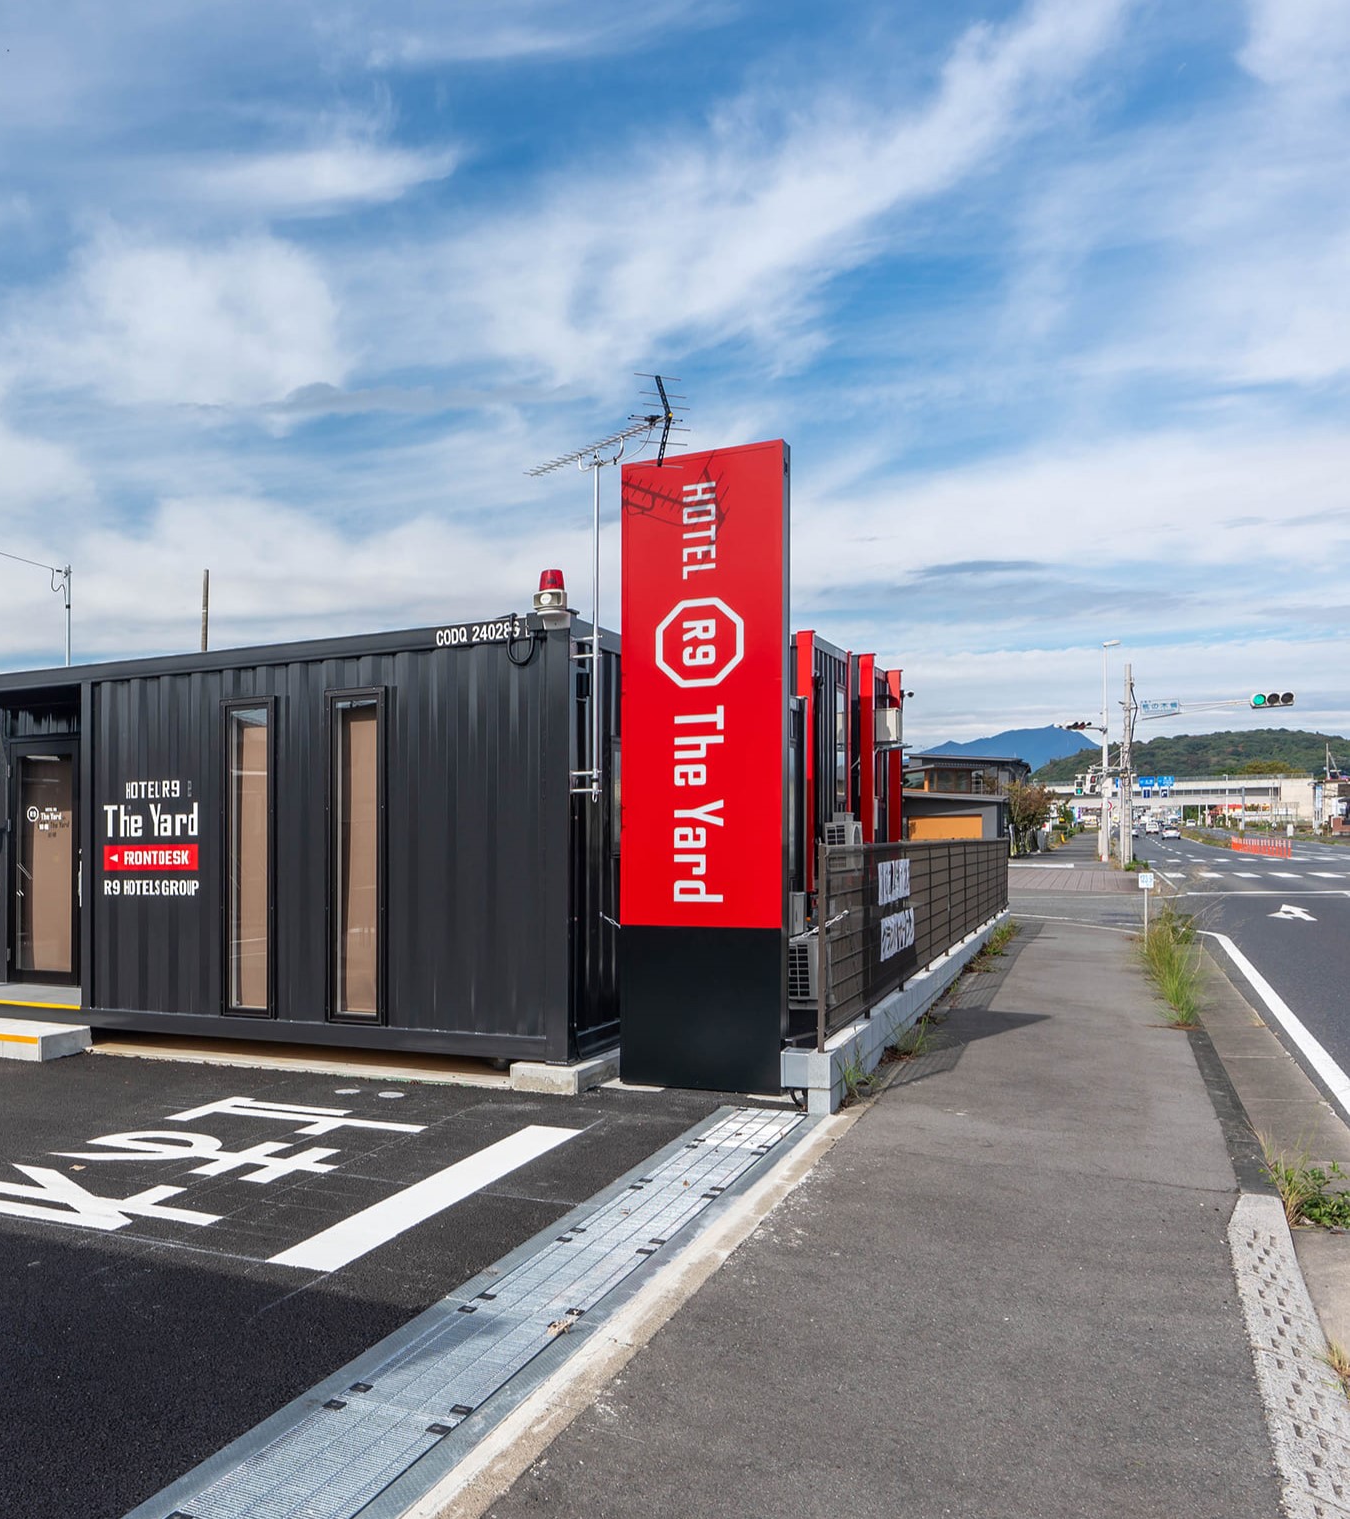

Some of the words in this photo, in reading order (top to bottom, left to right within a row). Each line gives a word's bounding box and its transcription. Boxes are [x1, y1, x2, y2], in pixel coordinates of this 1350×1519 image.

[682, 481, 716, 580] HOTEL
[435, 627, 468, 646] CODQ
[683, 618, 716, 667] R9
[674, 704, 725, 787] The
[125, 780, 160, 799] HOTEL
[162, 780, 181, 798] R9
[103, 804, 143, 838] The
[149, 801, 199, 837] Yard
[674, 799, 725, 903] Yard
[103, 880, 121, 896] R9
[123, 880, 161, 896] HOTELS
[161, 880, 200, 896] GROUP
